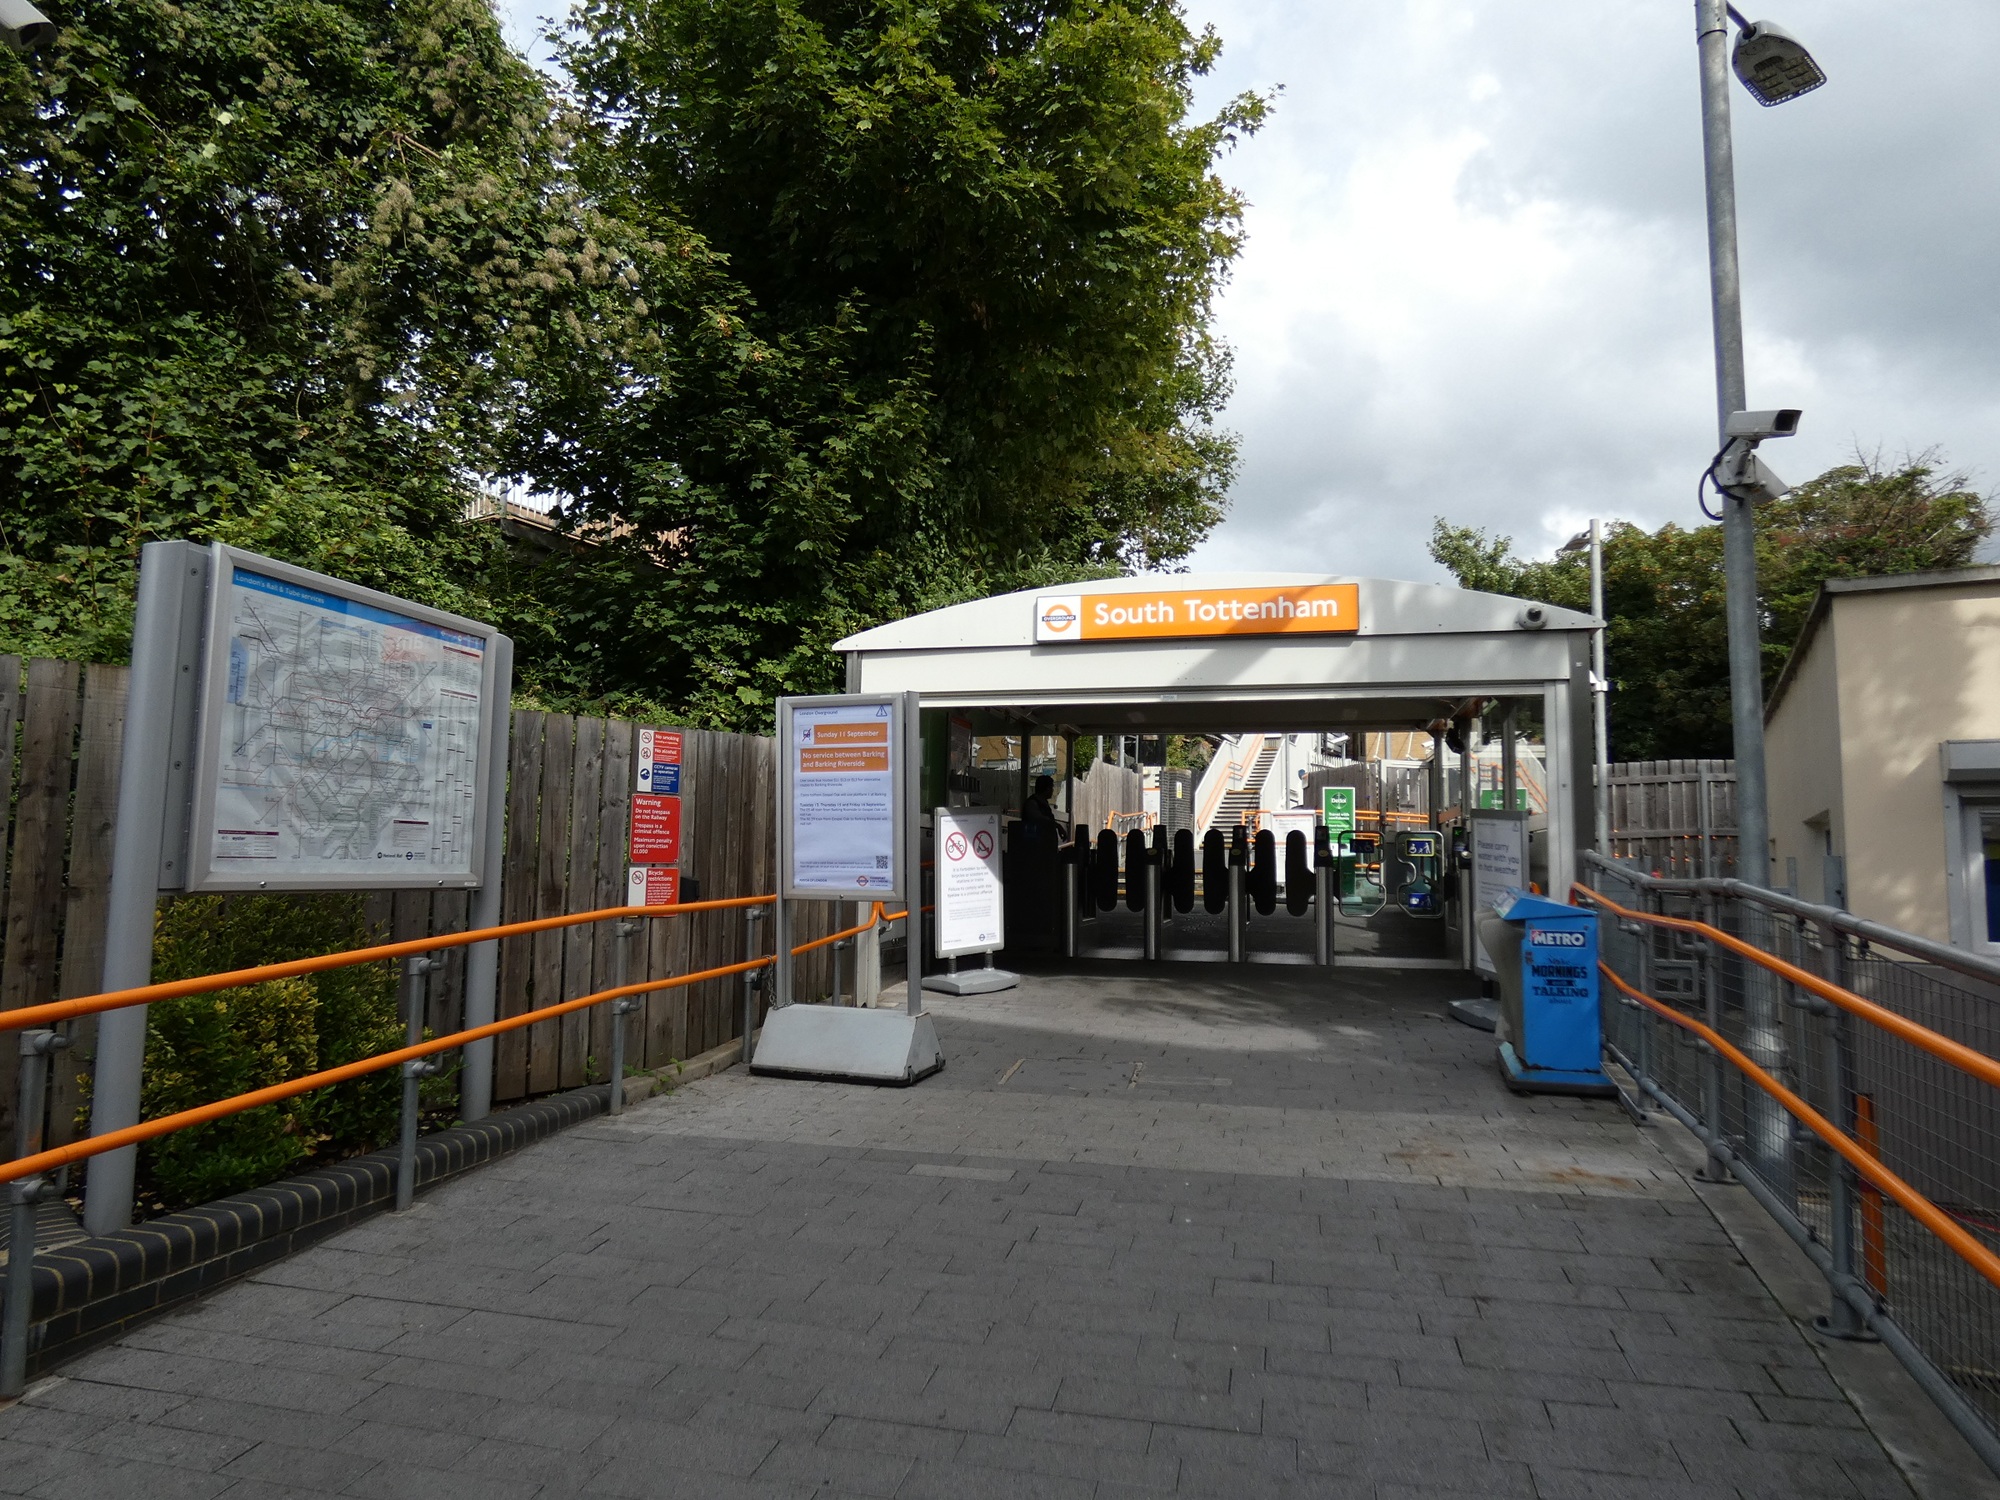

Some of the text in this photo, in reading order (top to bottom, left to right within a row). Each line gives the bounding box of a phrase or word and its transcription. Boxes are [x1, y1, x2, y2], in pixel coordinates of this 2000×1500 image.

[235, 574, 266, 588] London's
[1094, 596, 1338, 625] South Tottenham
[817, 731, 838, 739] Sunday
[846, 730, 879, 738] September
[635, 798, 662, 807] Warning
[1477, 839, 1509, 853] Please carry
[1508, 856, 1519, 865] you
[1533, 932, 1585, 946] METRO
[1531, 965, 1588, 979] MORNINGS
[1532, 986, 1589, 998] TALKING
